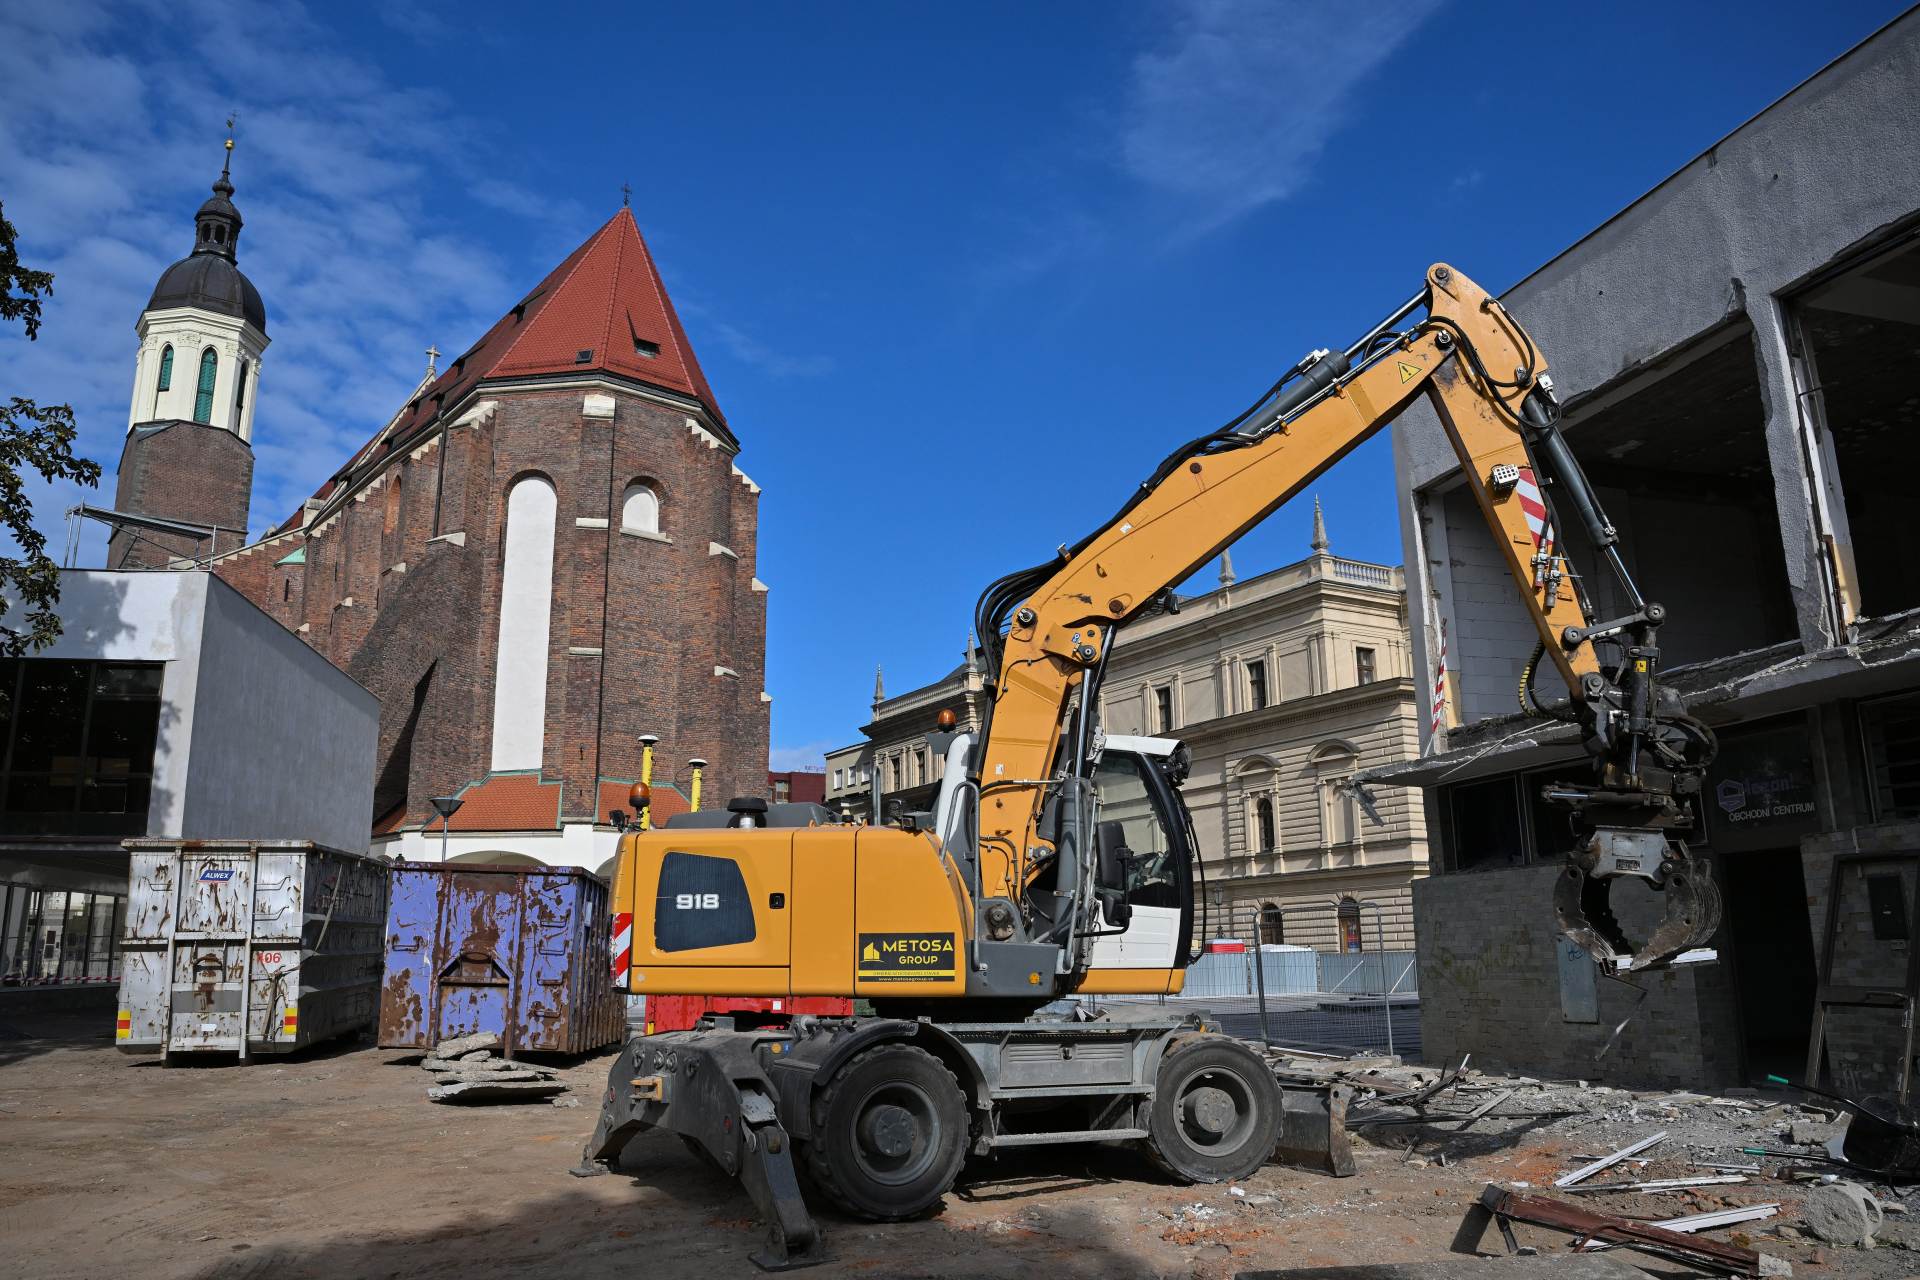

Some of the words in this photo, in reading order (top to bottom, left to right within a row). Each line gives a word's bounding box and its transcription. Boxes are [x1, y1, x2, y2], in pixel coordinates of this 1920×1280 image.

[1773, 802, 1815, 816] CENTRUM
[676, 893, 719, 909] 918
[882, 939, 953, 952] METOSA
[898, 955, 938, 965] GROUP
